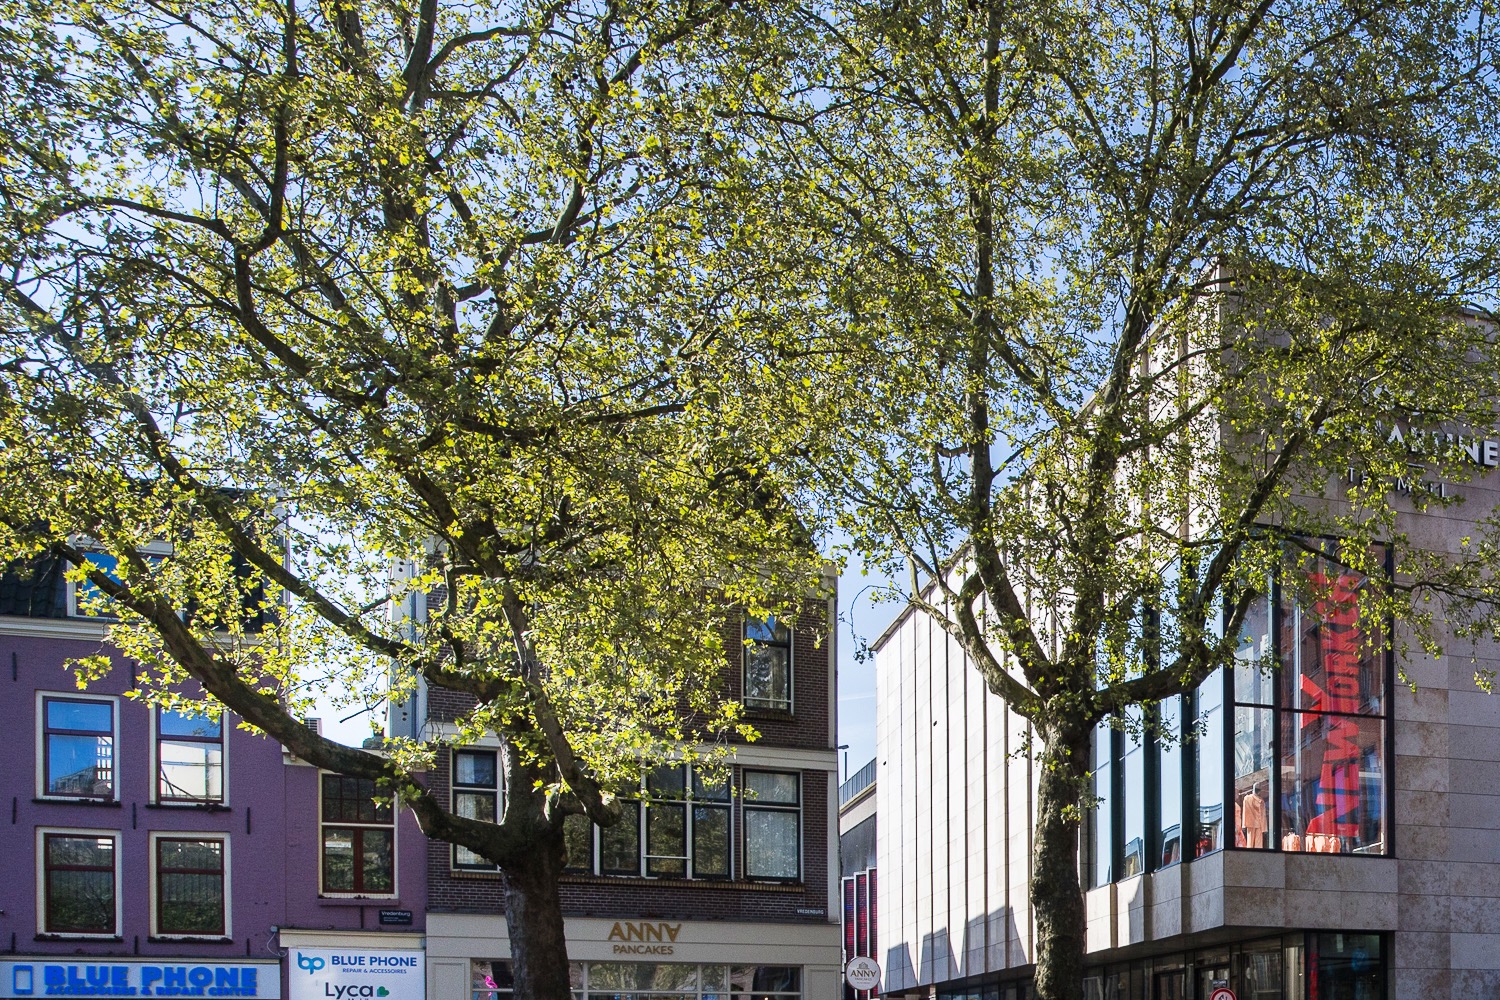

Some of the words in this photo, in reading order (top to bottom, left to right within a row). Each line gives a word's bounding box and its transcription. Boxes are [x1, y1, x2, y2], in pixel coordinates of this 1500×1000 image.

[613, 944, 674, 955] PANCAKES
[331, 955, 366, 966] BLUE
[369, 956, 418, 967] PHONE
[44, 965, 129, 986] BLUE
[141, 966, 258, 988] PHONE
[140, 986, 154, 996] &
[156, 986, 206, 996] REPAIR
[208, 986, 258, 997] CENTER
[325, 982, 374, 1000] Lyca
